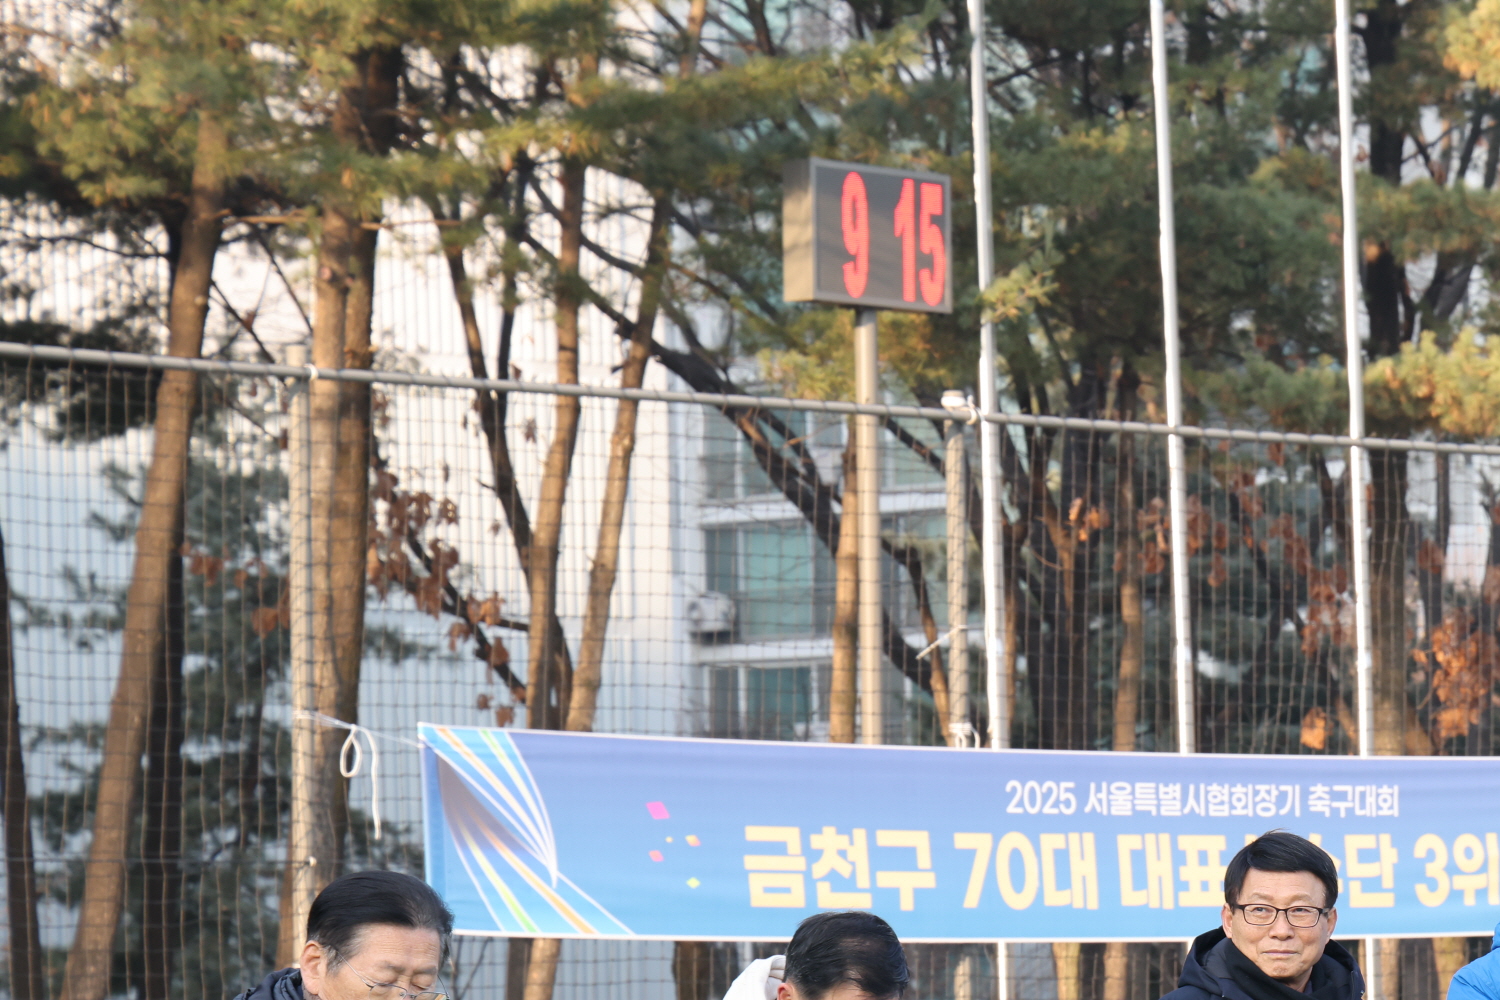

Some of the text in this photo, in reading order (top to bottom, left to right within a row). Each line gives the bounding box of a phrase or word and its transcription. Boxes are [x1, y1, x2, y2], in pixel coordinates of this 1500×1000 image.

[841, 171, 946, 307] 9 15
[1005, 780, 1399, 818] 2025 서울특별시협회장기 축구대회
[744, 825, 936, 911] 금천구
[954, 831, 1099, 910] 70대
[1117, 833, 1399, 909] 대표단
[1413, 832, 1500, 908] 3위
